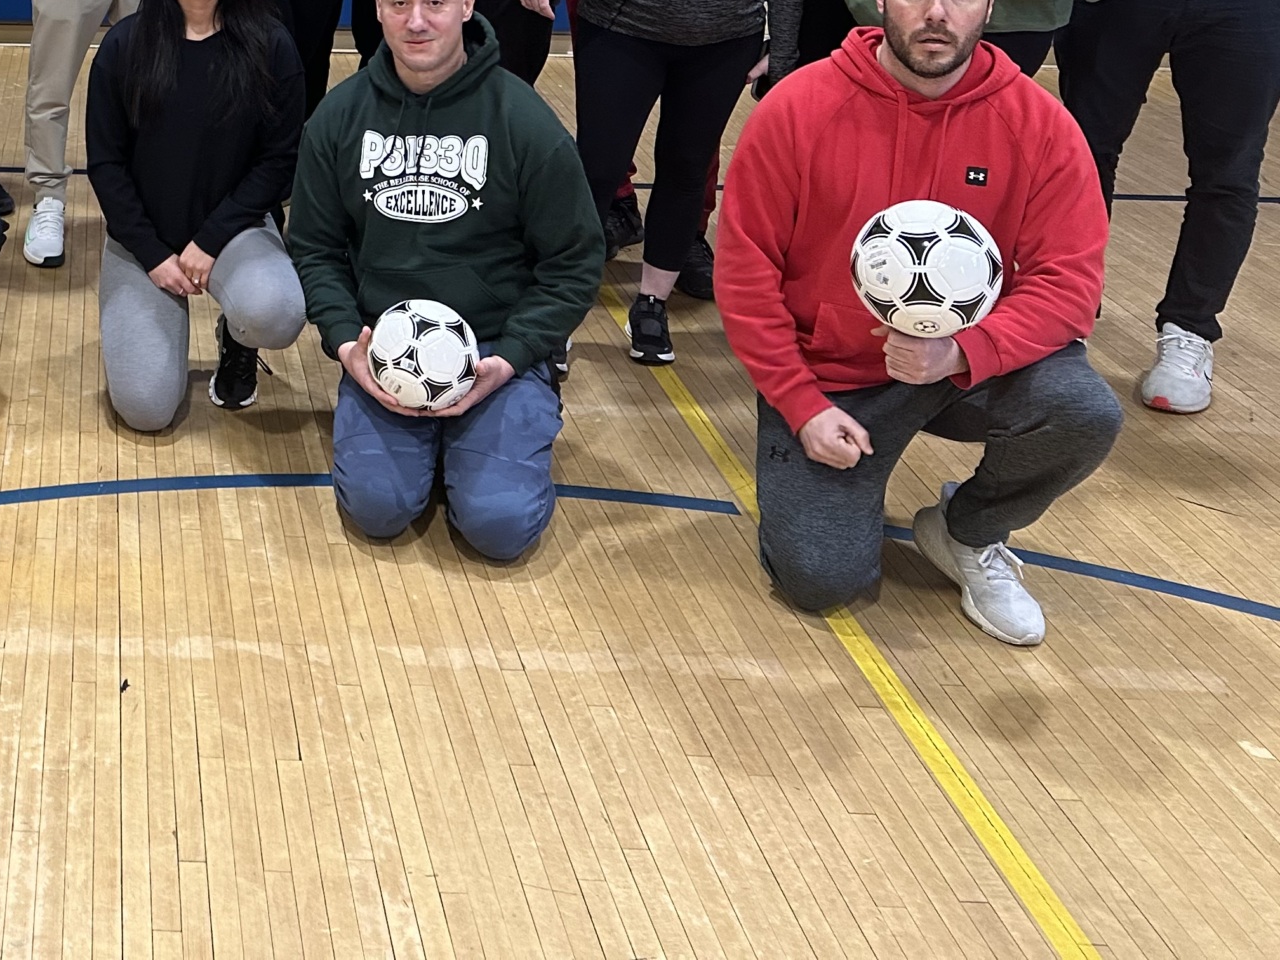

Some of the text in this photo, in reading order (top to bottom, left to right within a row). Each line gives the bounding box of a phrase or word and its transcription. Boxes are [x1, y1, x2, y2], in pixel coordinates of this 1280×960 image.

[359, 129, 489, 191] PS133Q
[372, 181, 390, 193] THE
[430, 175, 460, 191] SCHOOL
[458, 185, 472, 197] OF
[385, 188, 457, 217] EXCELLENCE
